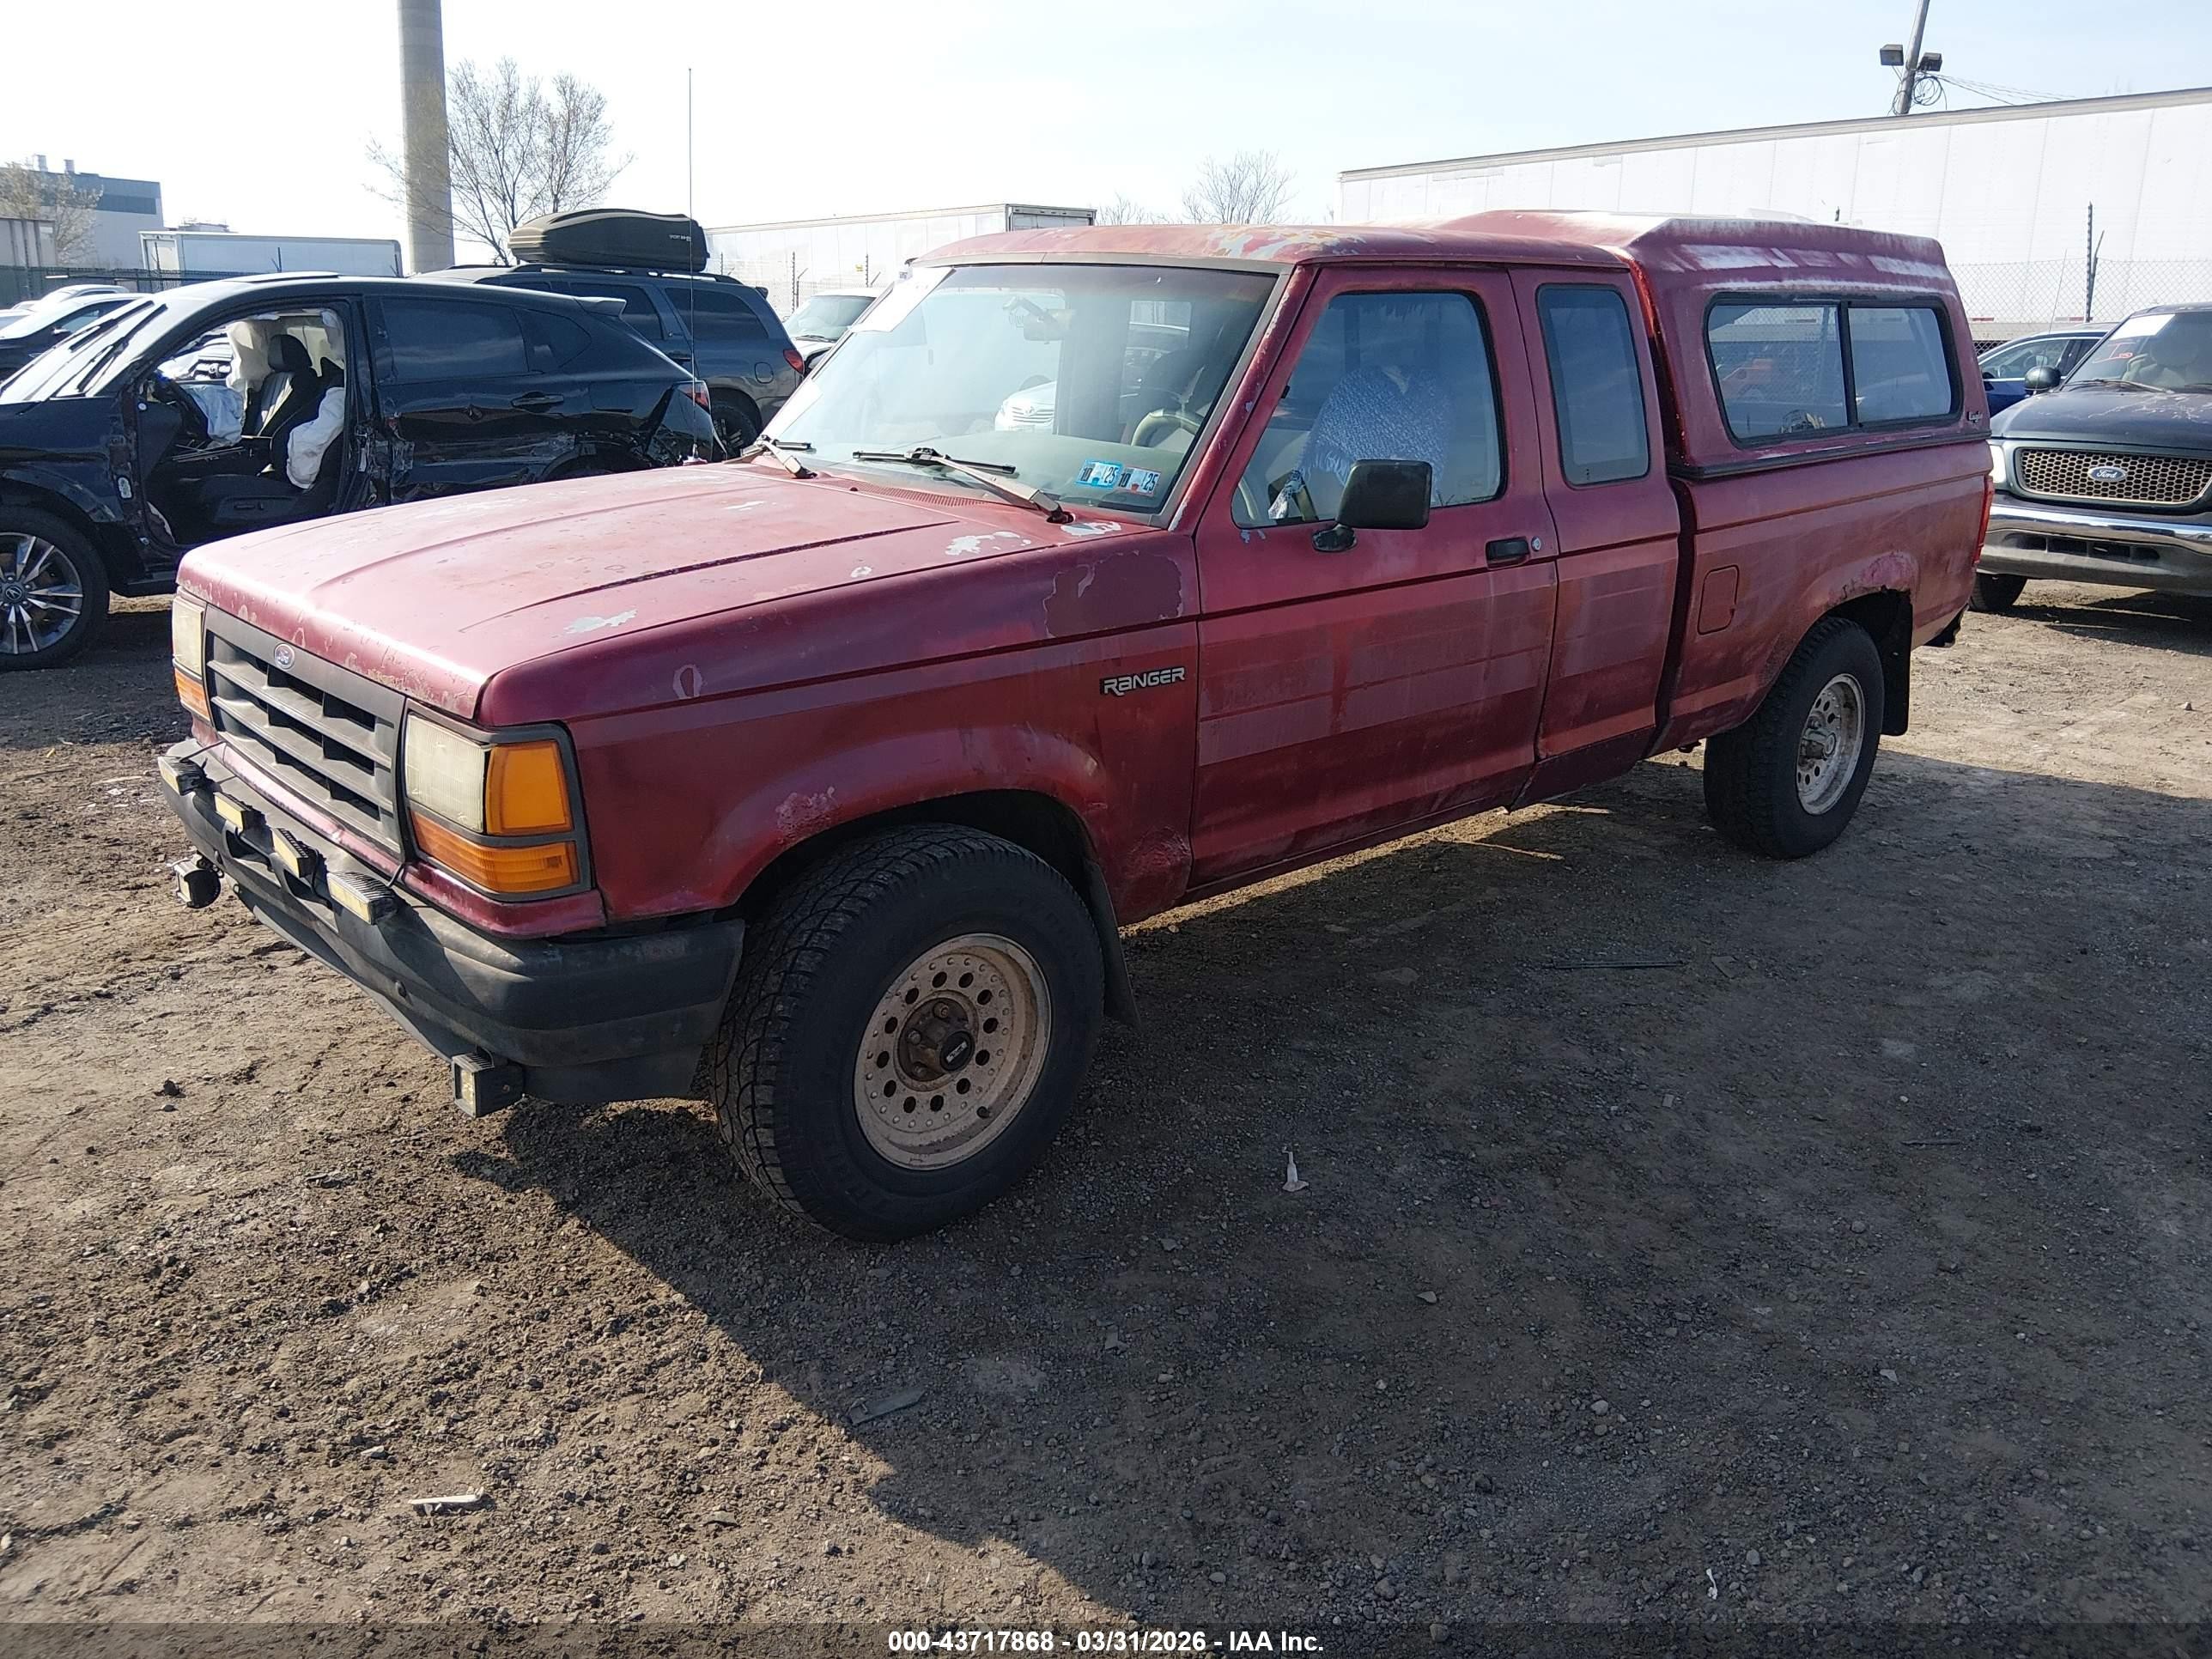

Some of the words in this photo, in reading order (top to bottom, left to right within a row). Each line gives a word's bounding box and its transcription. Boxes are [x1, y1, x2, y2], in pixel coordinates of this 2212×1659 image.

[1081, 467, 1093, 482] 10
[1104, 466, 1119, 484] 25
[1118, 472, 1132, 488] 10
[1143, 473, 1158, 491] 25
[2096, 469, 2118, 478] Ford
[1103, 667, 1185, 696] RANGER
